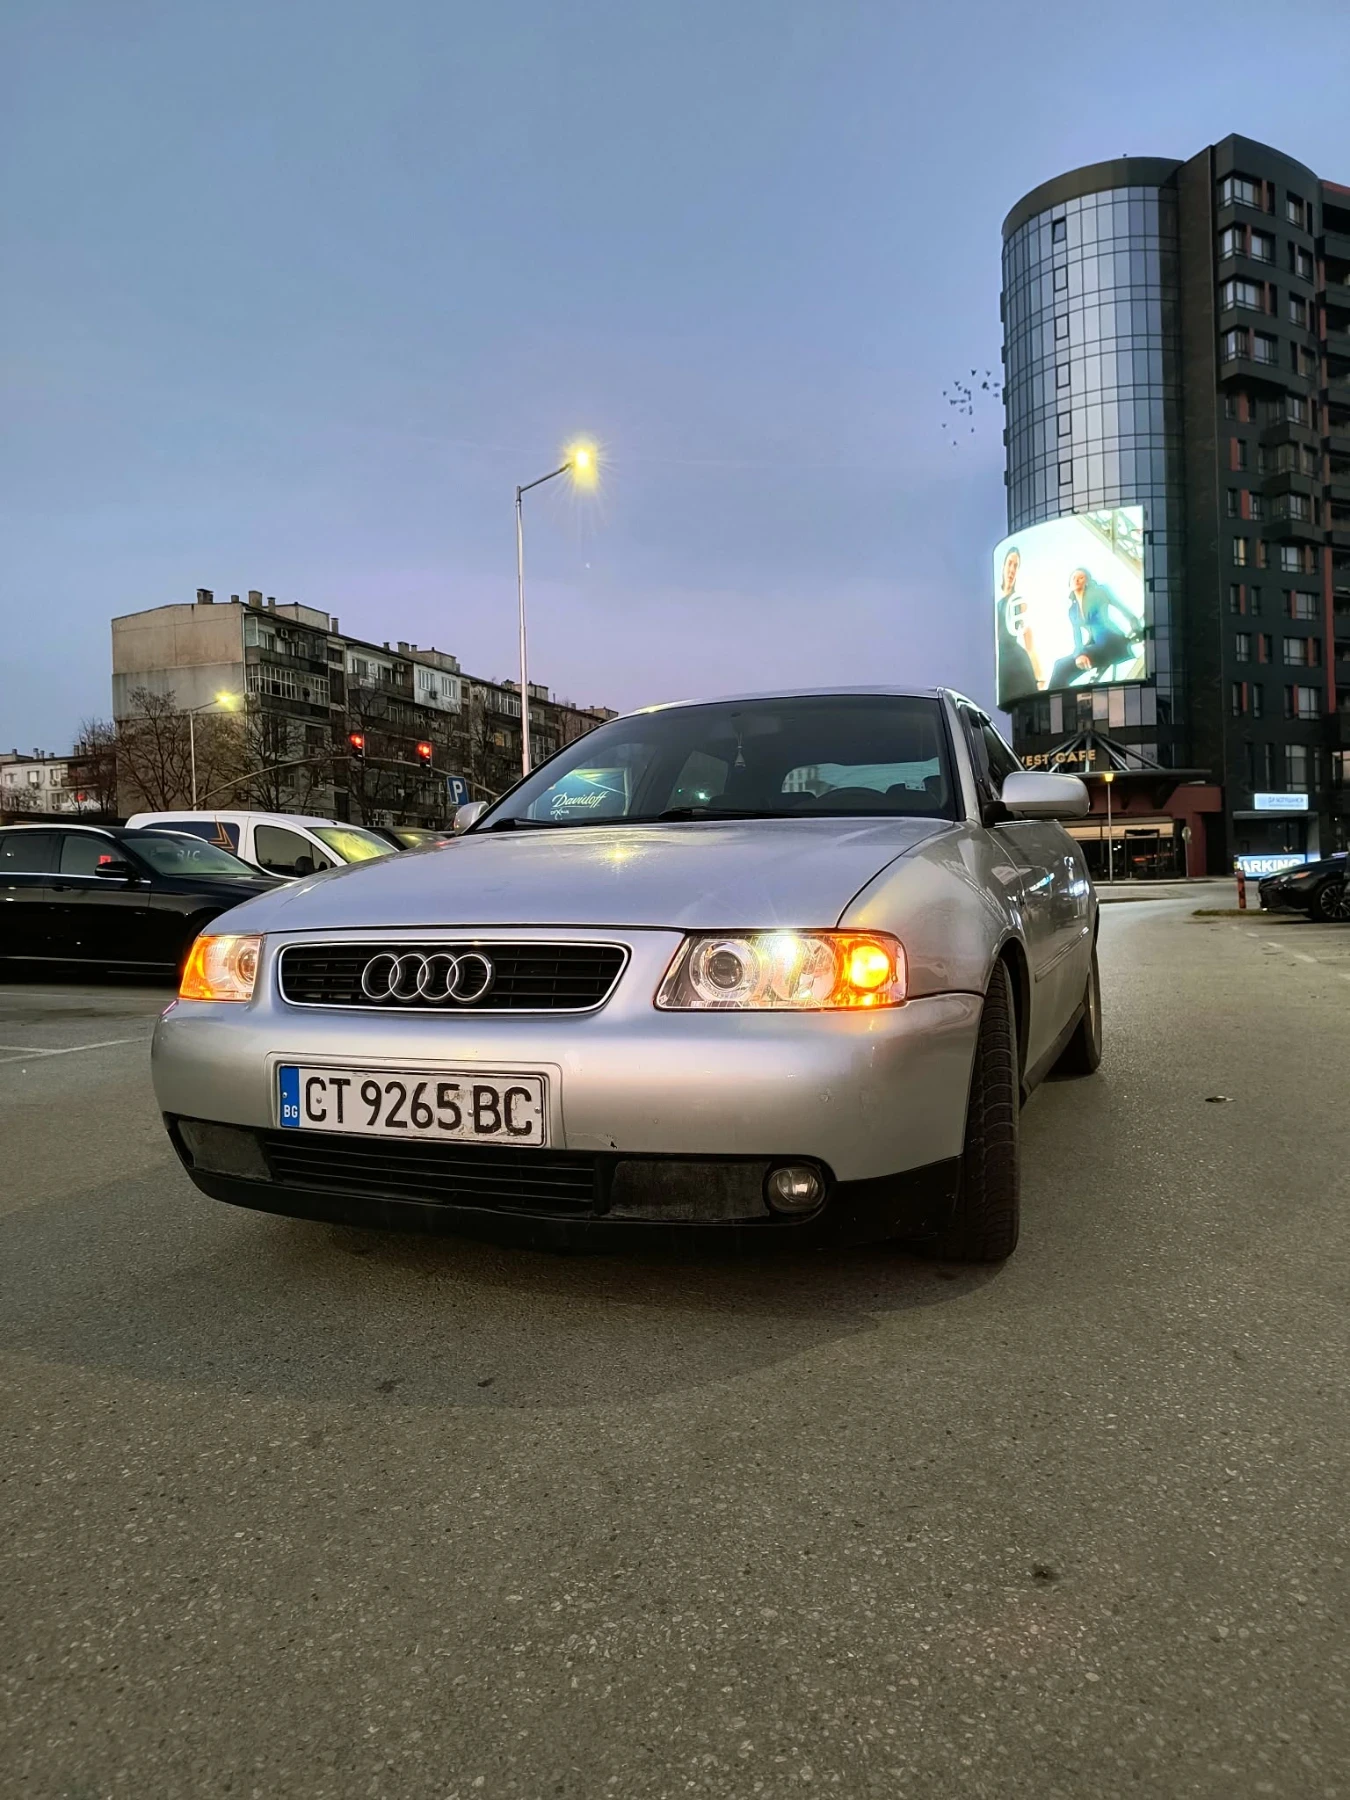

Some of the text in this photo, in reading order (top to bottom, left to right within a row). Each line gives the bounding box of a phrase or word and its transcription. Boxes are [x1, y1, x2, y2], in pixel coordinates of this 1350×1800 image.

[1021, 749, 1096, 766] EST CAFE
[452, 780, 463, 804] P
[552, 791, 609, 808] Davidoff
[284, 1105, 298, 1118] BG
[305, 1076, 532, 1136] CT 9265 BC
